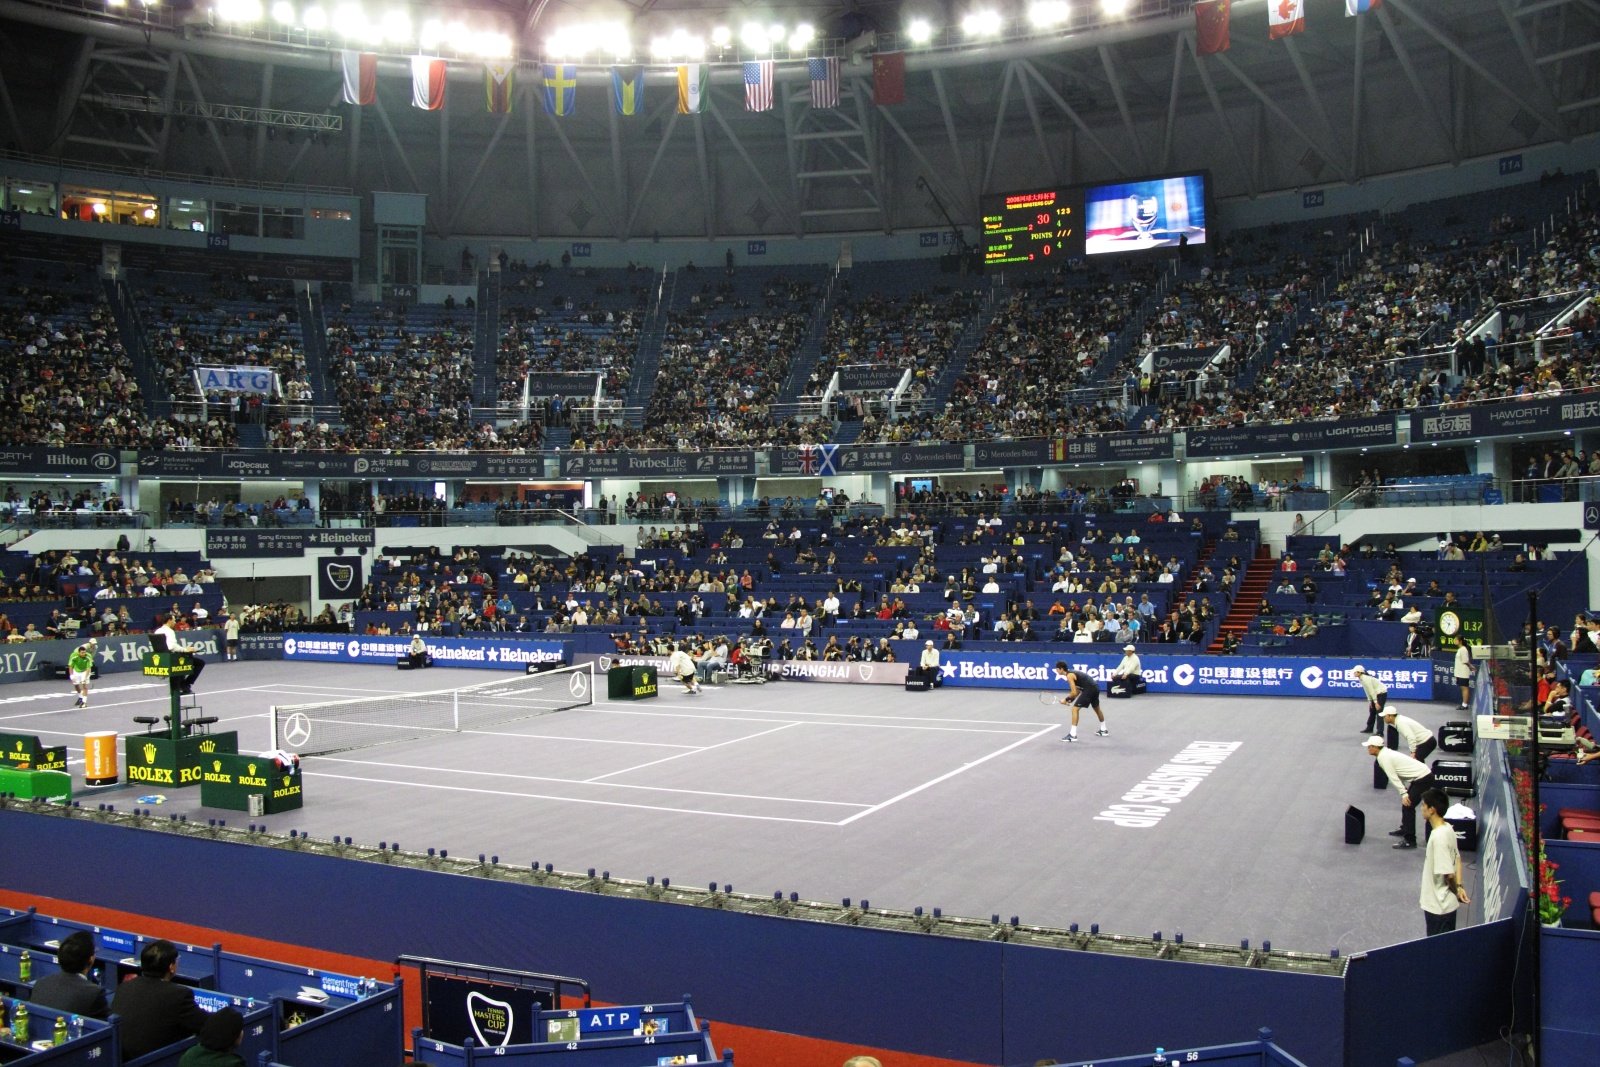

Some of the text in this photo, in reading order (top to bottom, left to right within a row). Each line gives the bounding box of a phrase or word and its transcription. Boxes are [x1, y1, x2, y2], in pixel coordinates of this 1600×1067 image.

[0, 214, 18, 225] 5A
[1037, 214, 1049, 224] 30
[209, 236, 228, 246] 15B
[1031, 232, 1053, 240] POINTS
[1043, 244, 1051, 255] 0
[393, 288, 412, 297] 14A
[204, 370, 269, 389] ARG
[1490, 407, 1549, 421] HAWORTH
[1561, 401, 1600, 420] 网球天
[1326, 423, 1392, 436] LIGHTHOUSE
[1209, 434, 1248, 443] ParkwayHealth
[1069, 442, 1097, 453] 申能
[915, 453, 961, 461] Mercedes-Benz
[991, 449, 1038, 458] Mercedes-Benz
[47, 454, 88, 466] Hilton
[228, 461, 269, 469] JCDecaux
[371, 459, 409, 467] 太平洋保险
[629, 456, 687, 468] ForbesLife
[320, 532, 372, 542] Heineken
[297, 640, 345, 651] 中国建设银行
[361, 643, 412, 653] 中国建设银行
[426, 645, 485, 661] Heineken
[500, 647, 562, 663] Heineken
[144, 666, 169, 676] ROLEX
[171, 664, 192, 672] ROLEX
[782, 664, 850, 679] SHANGHAI
[959, 661, 1049, 680] Heineken
[1198, 666, 1293, 679] 中国建设银行
[1434, 665, 1449, 674] Sony
[1327, 669, 1428, 683] 中国设银行
[1198, 677, 1281, 686] China Construction Bank
[1327, 680, 1348, 688] China
[635, 685, 656, 695] ROLEX
[9, 752, 31, 761] ROLEX
[93, 739, 101, 775] HEAD
[36, 761, 65, 770] ROLEX
[129, 765, 174, 783] ROLEX
[204, 772, 231, 783] ROLEX
[1434, 774, 1468, 782] LACOSTE
[239, 776, 267, 787] ROLEX
[1092, 740, 1244, 828] TENNIS MASTERS CUP
[273, 786, 300, 798] ROLEX
[322, 976, 358, 989] element fres
[194, 995, 213, 1006] ement
[567, 1010, 577, 1018] 38
[643, 1005, 653, 1013] 40
[474, 1010, 505, 1022] MASTERS
[590, 1012, 630, 1027] ATP
[487, 1019, 506, 1030] CUP
[644, 1036, 655, 1045] 44
[435, 1043, 443, 1051] 38
[494, 1047, 506, 1056] 40
[566, 1042, 578, 1051] 42
[1186, 1051, 1199, 1061] 56
